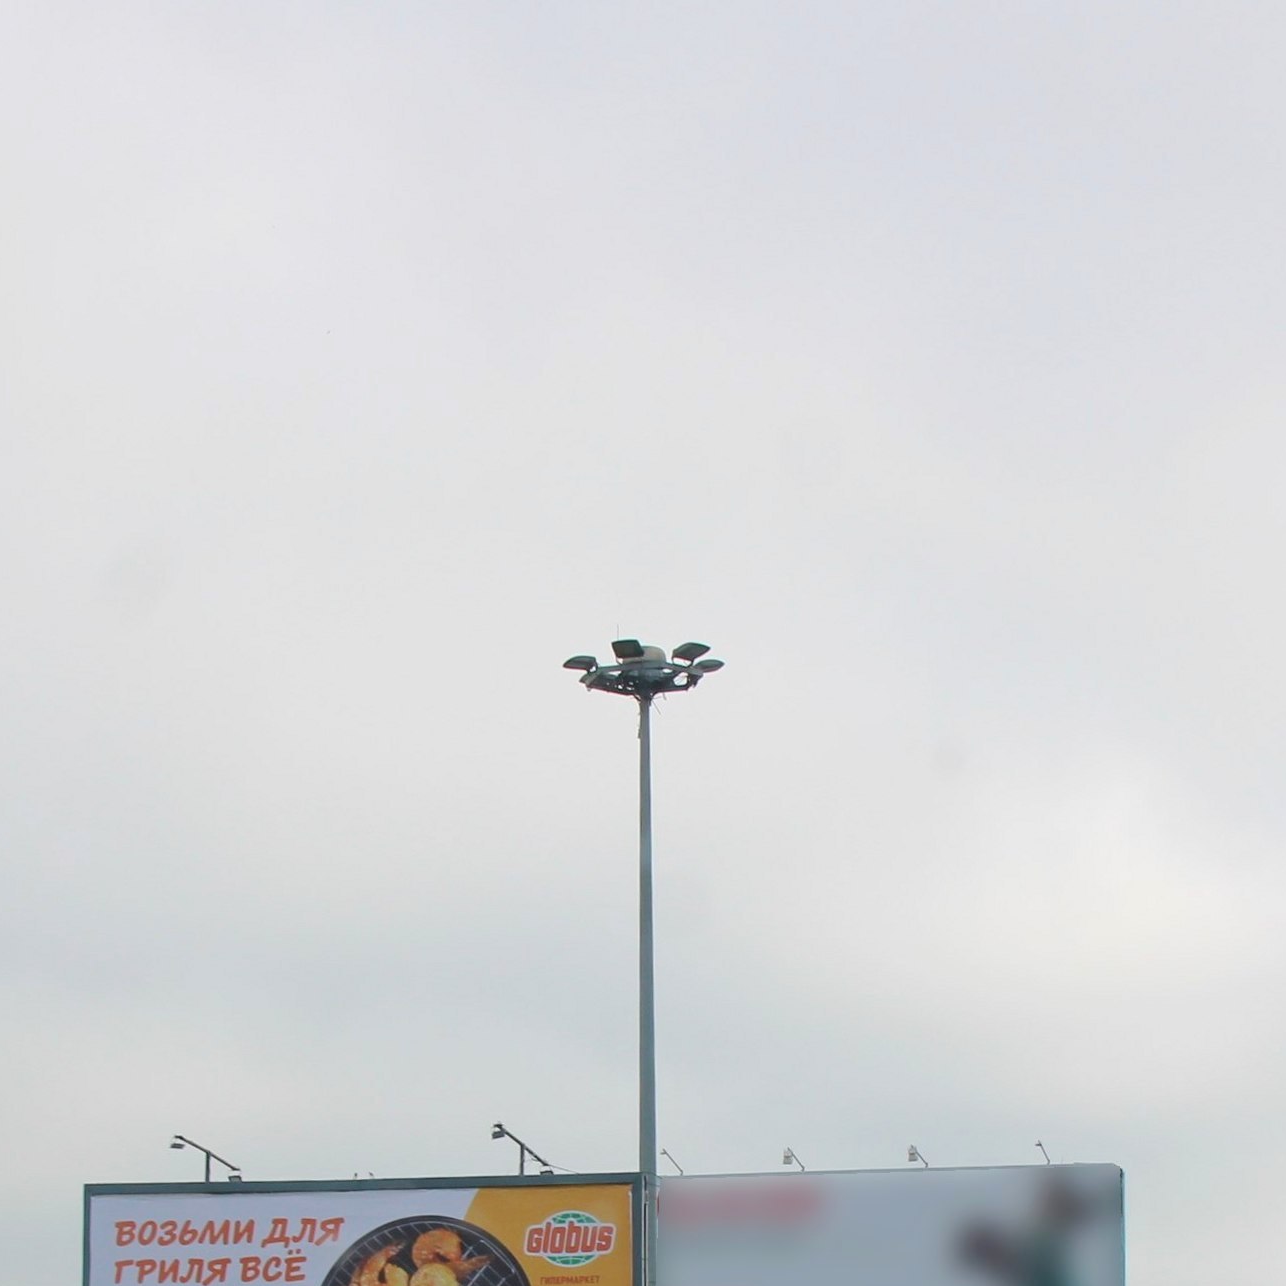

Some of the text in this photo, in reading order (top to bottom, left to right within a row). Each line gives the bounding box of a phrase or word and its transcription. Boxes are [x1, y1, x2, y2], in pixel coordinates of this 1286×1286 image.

[114, 1217, 345, 1248] ВОЗЬМИ ДЛЯ
[114, 1249, 307, 1286] ГРИЛЯ ВСЁ
[540, 1275, 600, 1285] ГИПЕРМАРКЕТ
